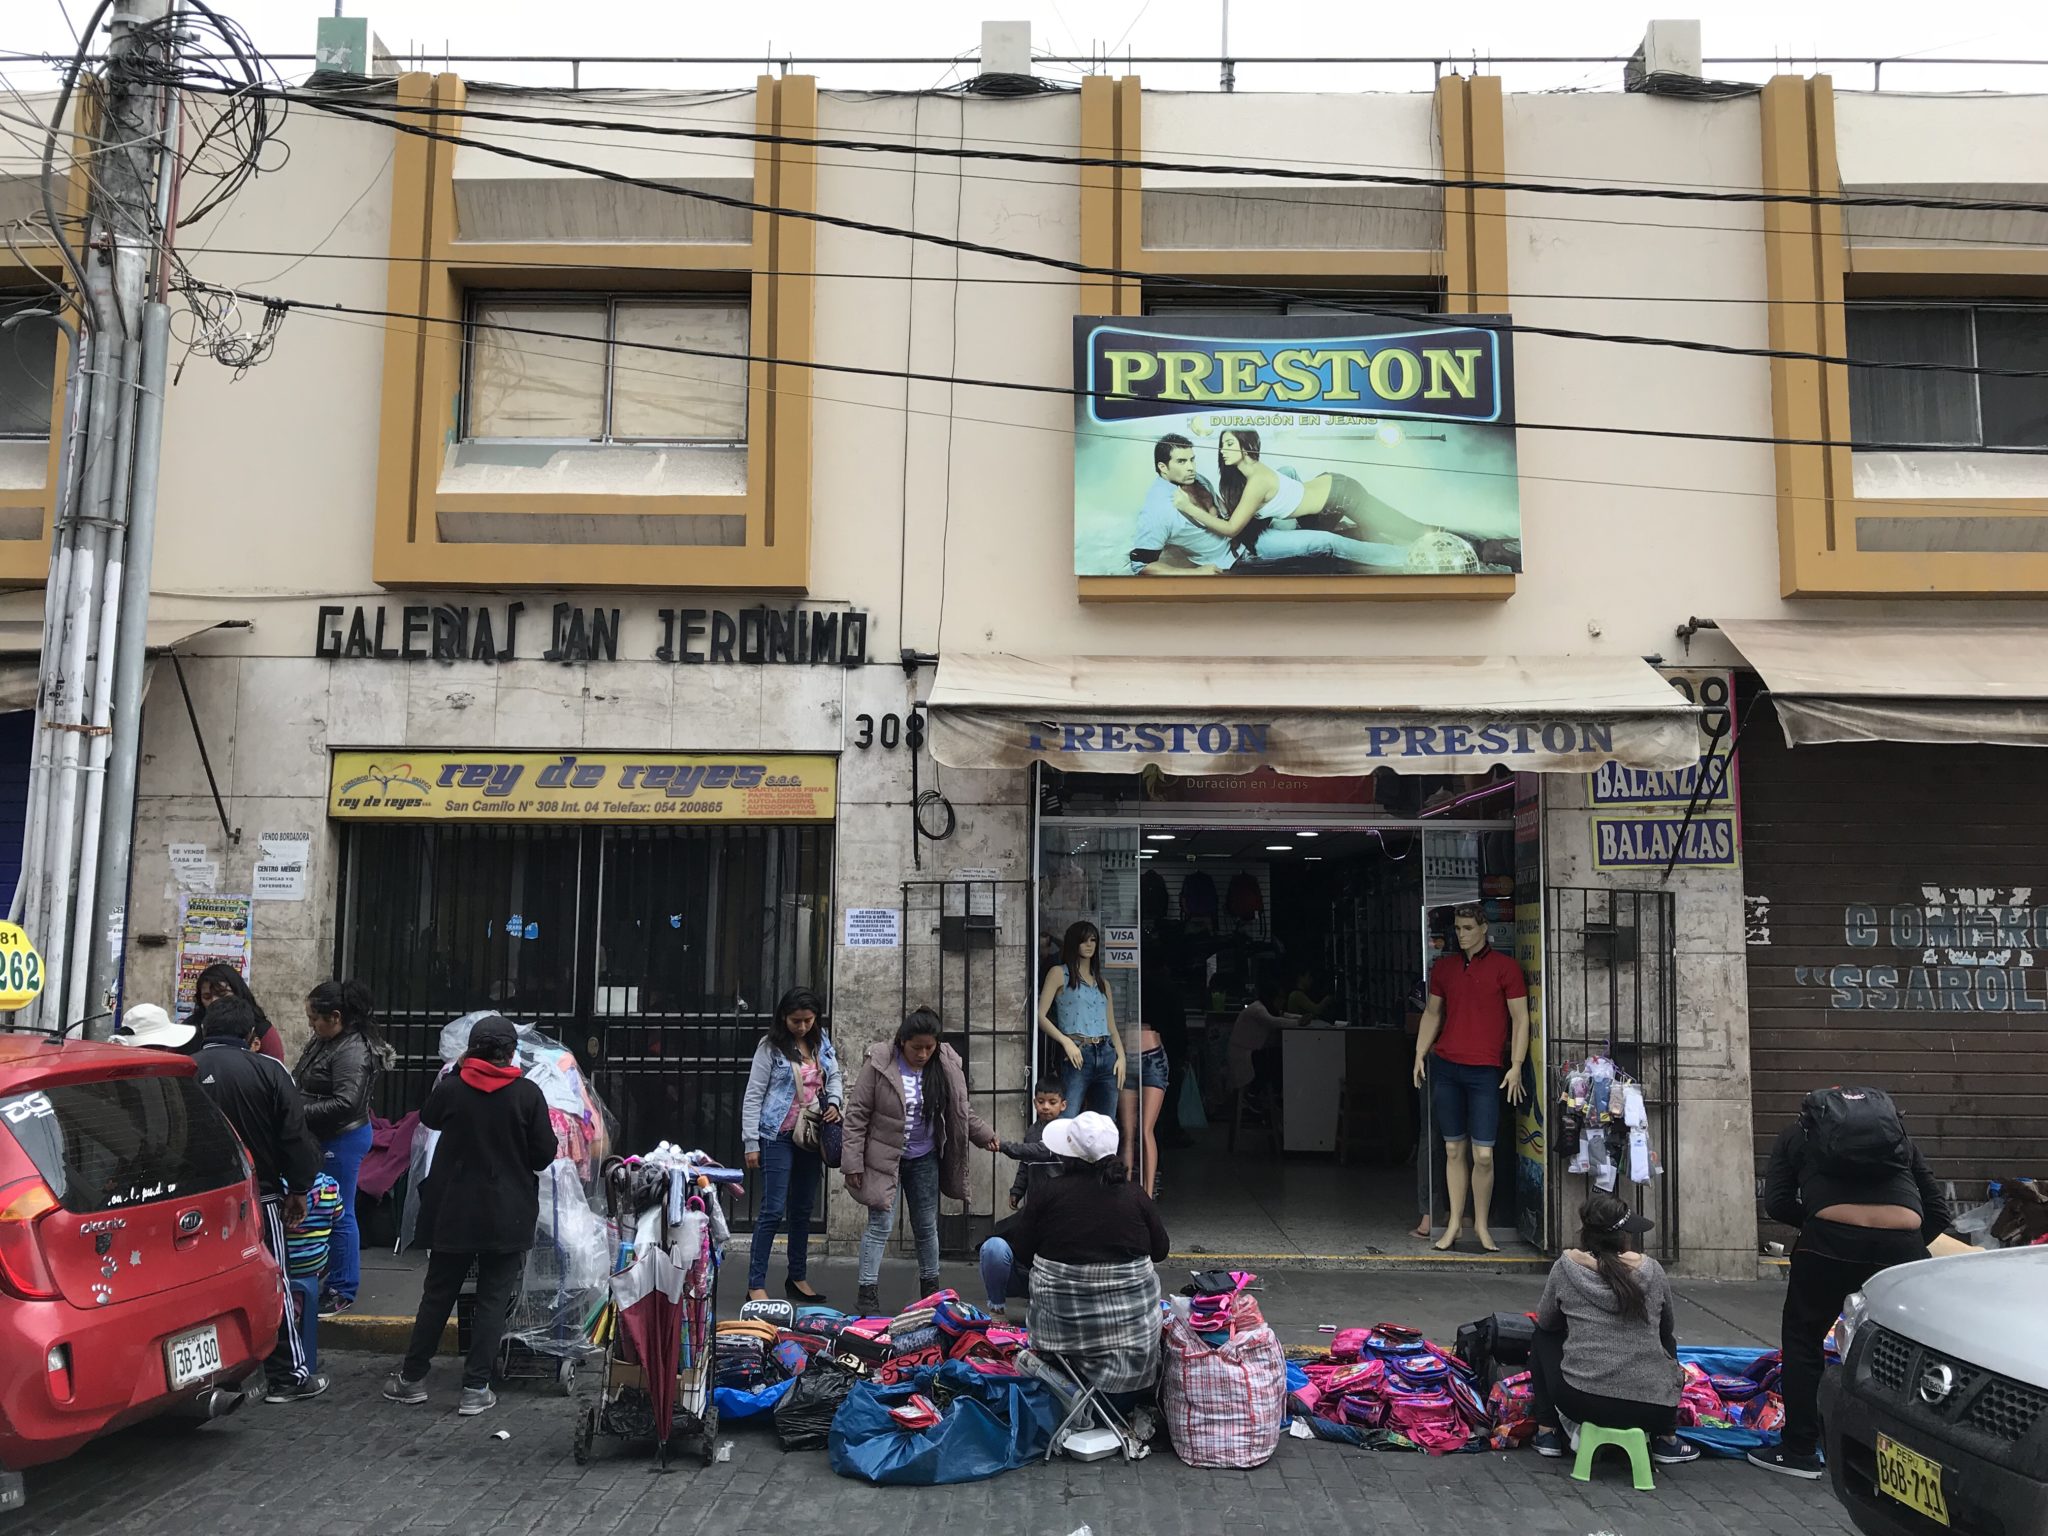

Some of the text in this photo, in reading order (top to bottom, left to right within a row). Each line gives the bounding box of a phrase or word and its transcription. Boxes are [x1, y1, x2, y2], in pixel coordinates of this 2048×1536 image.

[1104, 348, 1483, 402] PRESTON
[1210, 412, 1378, 426] DURACIÓN EN JEANS
[316, 601, 868, 664] GALERIAS SAN JERONIMO
[855, 712, 925, 749] 308
[1029, 720, 1613, 758] PRESTON PRESTON
[436, 763, 525, 796] rey
[535, 756, 606, 788] de
[618, 764, 768, 797] reyes
[1186, 776, 1309, 790] Duración en Jeans
[337, 795, 423, 810] rey de reyes
[444, 800, 468, 812] San
[472, 800, 515, 812] Camilo
[537, 801, 559, 812] 308
[561, 801, 580, 812] Int.
[584, 802, 600, 813] 04
[603, 801, 650, 813] Telefax:
[654, 802, 677, 813] 054
[679, 802, 723, 813] 200865
[261, 832, 279, 841] VENDO
[1600, 821, 1730, 861] BALANZAS
[1110, 930, 1135, 941] VISA
[1110, 951, 1134, 961] VISA
[182, 1213, 200, 1229] KIA
[743, 1302, 790, 1315] adidas
[248, 1387, 260, 1398] KIA
[1878, 1450, 1943, 1517] B6B-711
